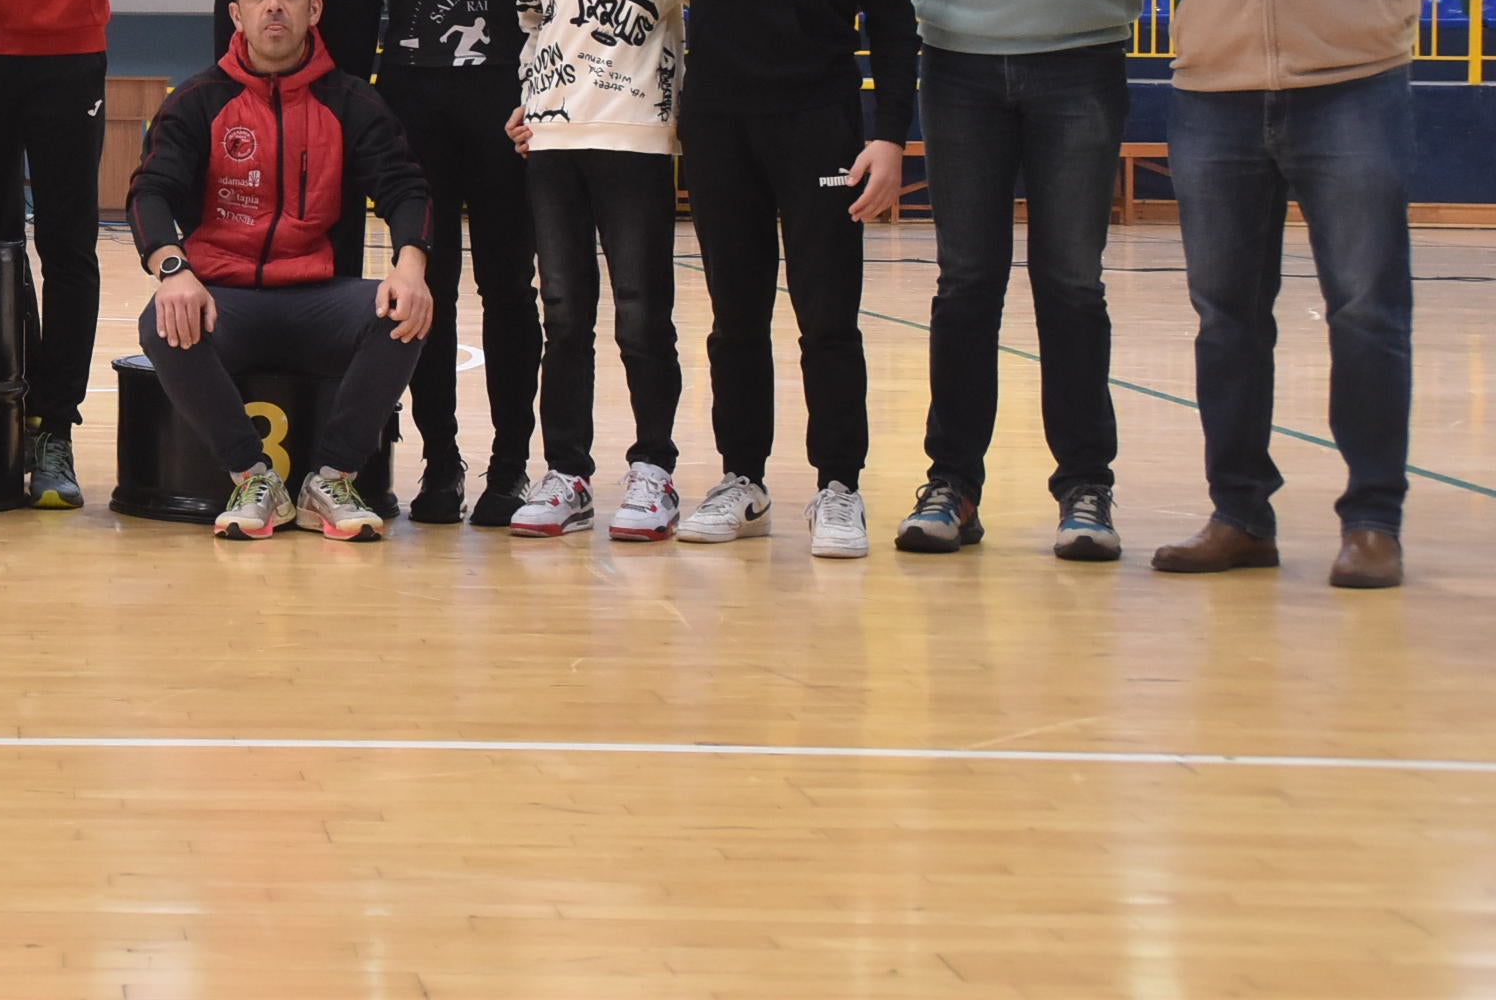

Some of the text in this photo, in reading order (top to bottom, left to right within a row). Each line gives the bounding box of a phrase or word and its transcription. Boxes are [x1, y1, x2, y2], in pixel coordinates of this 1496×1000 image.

[577, 52, 613, 68] avenue
[593, 80, 625, 92] street
[244, 401, 291, 483] 3
